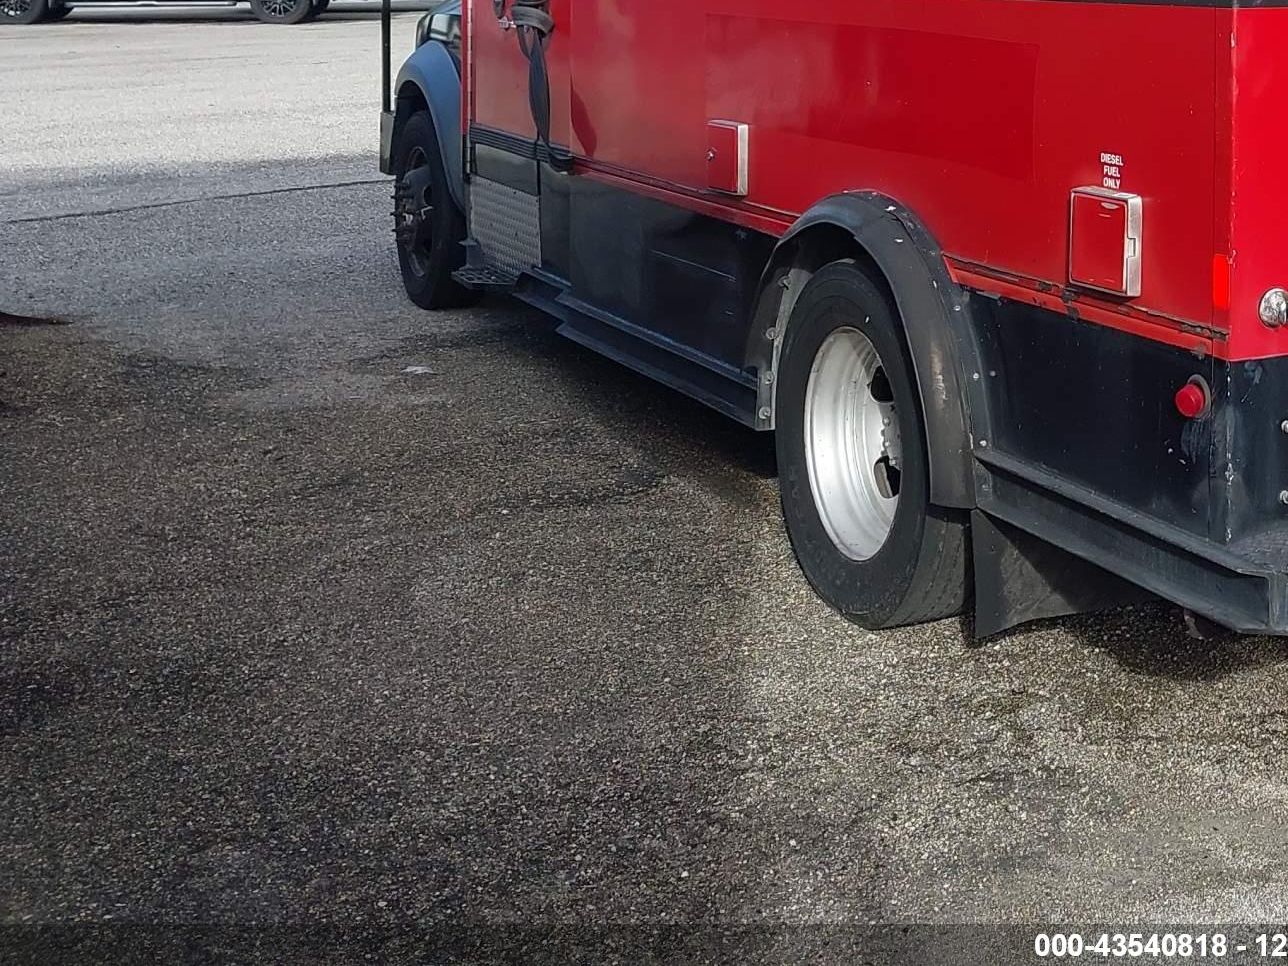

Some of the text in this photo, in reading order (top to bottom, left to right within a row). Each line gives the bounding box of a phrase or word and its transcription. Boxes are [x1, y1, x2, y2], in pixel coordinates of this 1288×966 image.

[1100, 152, 1124, 166] DIESEL
[1103, 165, 1120, 178] FUEL
[1103, 177, 1120, 189] ONLY
